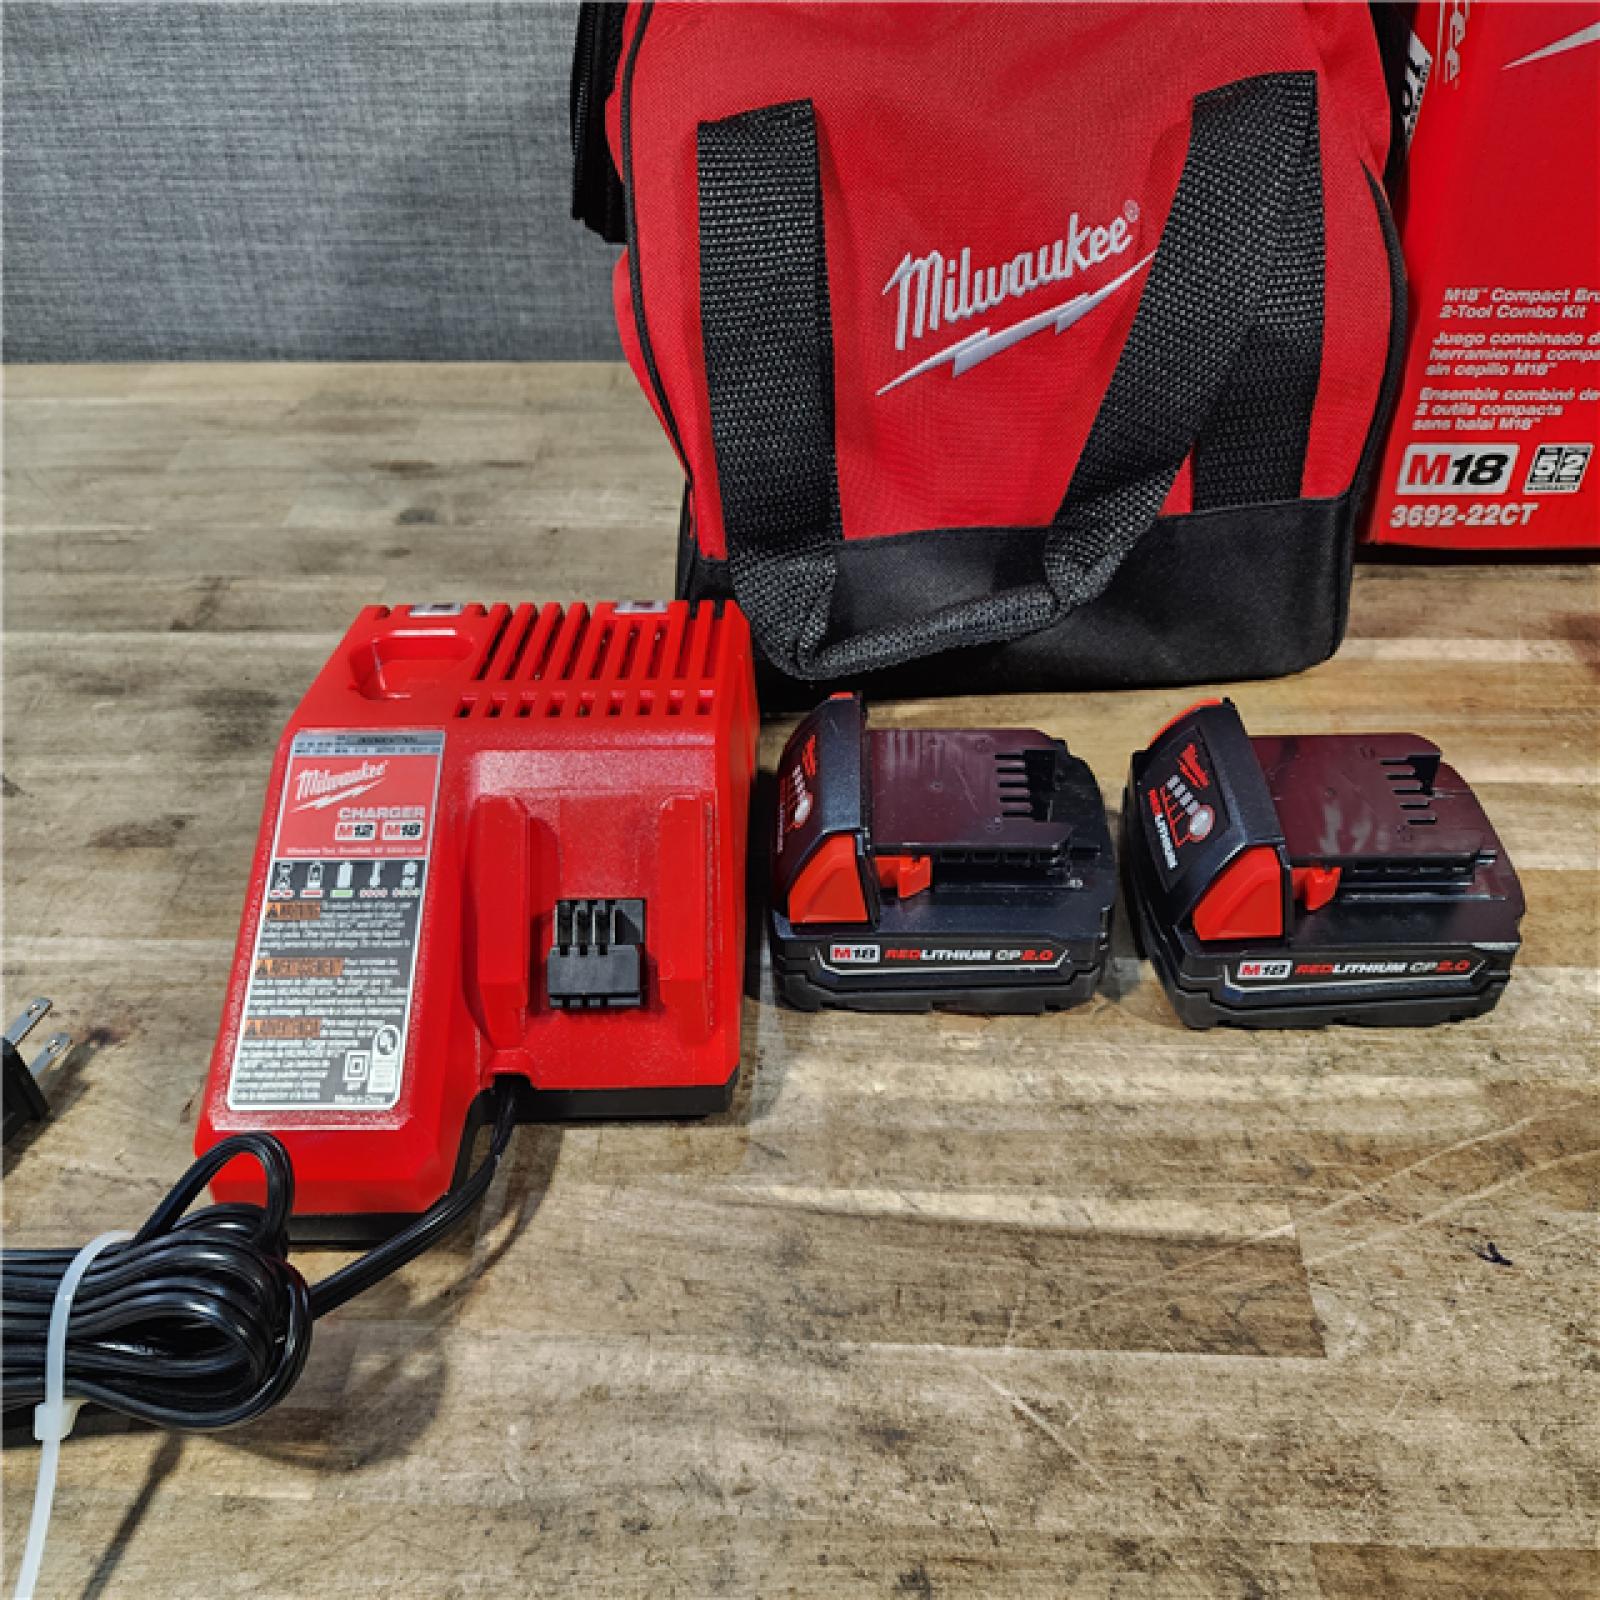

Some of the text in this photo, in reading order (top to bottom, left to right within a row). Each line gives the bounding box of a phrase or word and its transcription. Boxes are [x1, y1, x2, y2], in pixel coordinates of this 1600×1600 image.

[1491, 287, 1570, 305] Compact
[1440, 304, 1587, 319] 2-Tool Combo Kit
[1432, 331, 1486, 348] Juego
[1489, 331, 1584, 346] combinado
[1429, 347, 1541, 361] herramientas
[1425, 363, 1451, 376] sin
[1420, 387, 1500, 401] Ensemble
[1415, 402, 1428, 416] 2
[1405, 452, 1510, 486] M18
[1389, 502, 1540, 528] 3692-22CT
[337, 806, 426, 820] CHARGER
